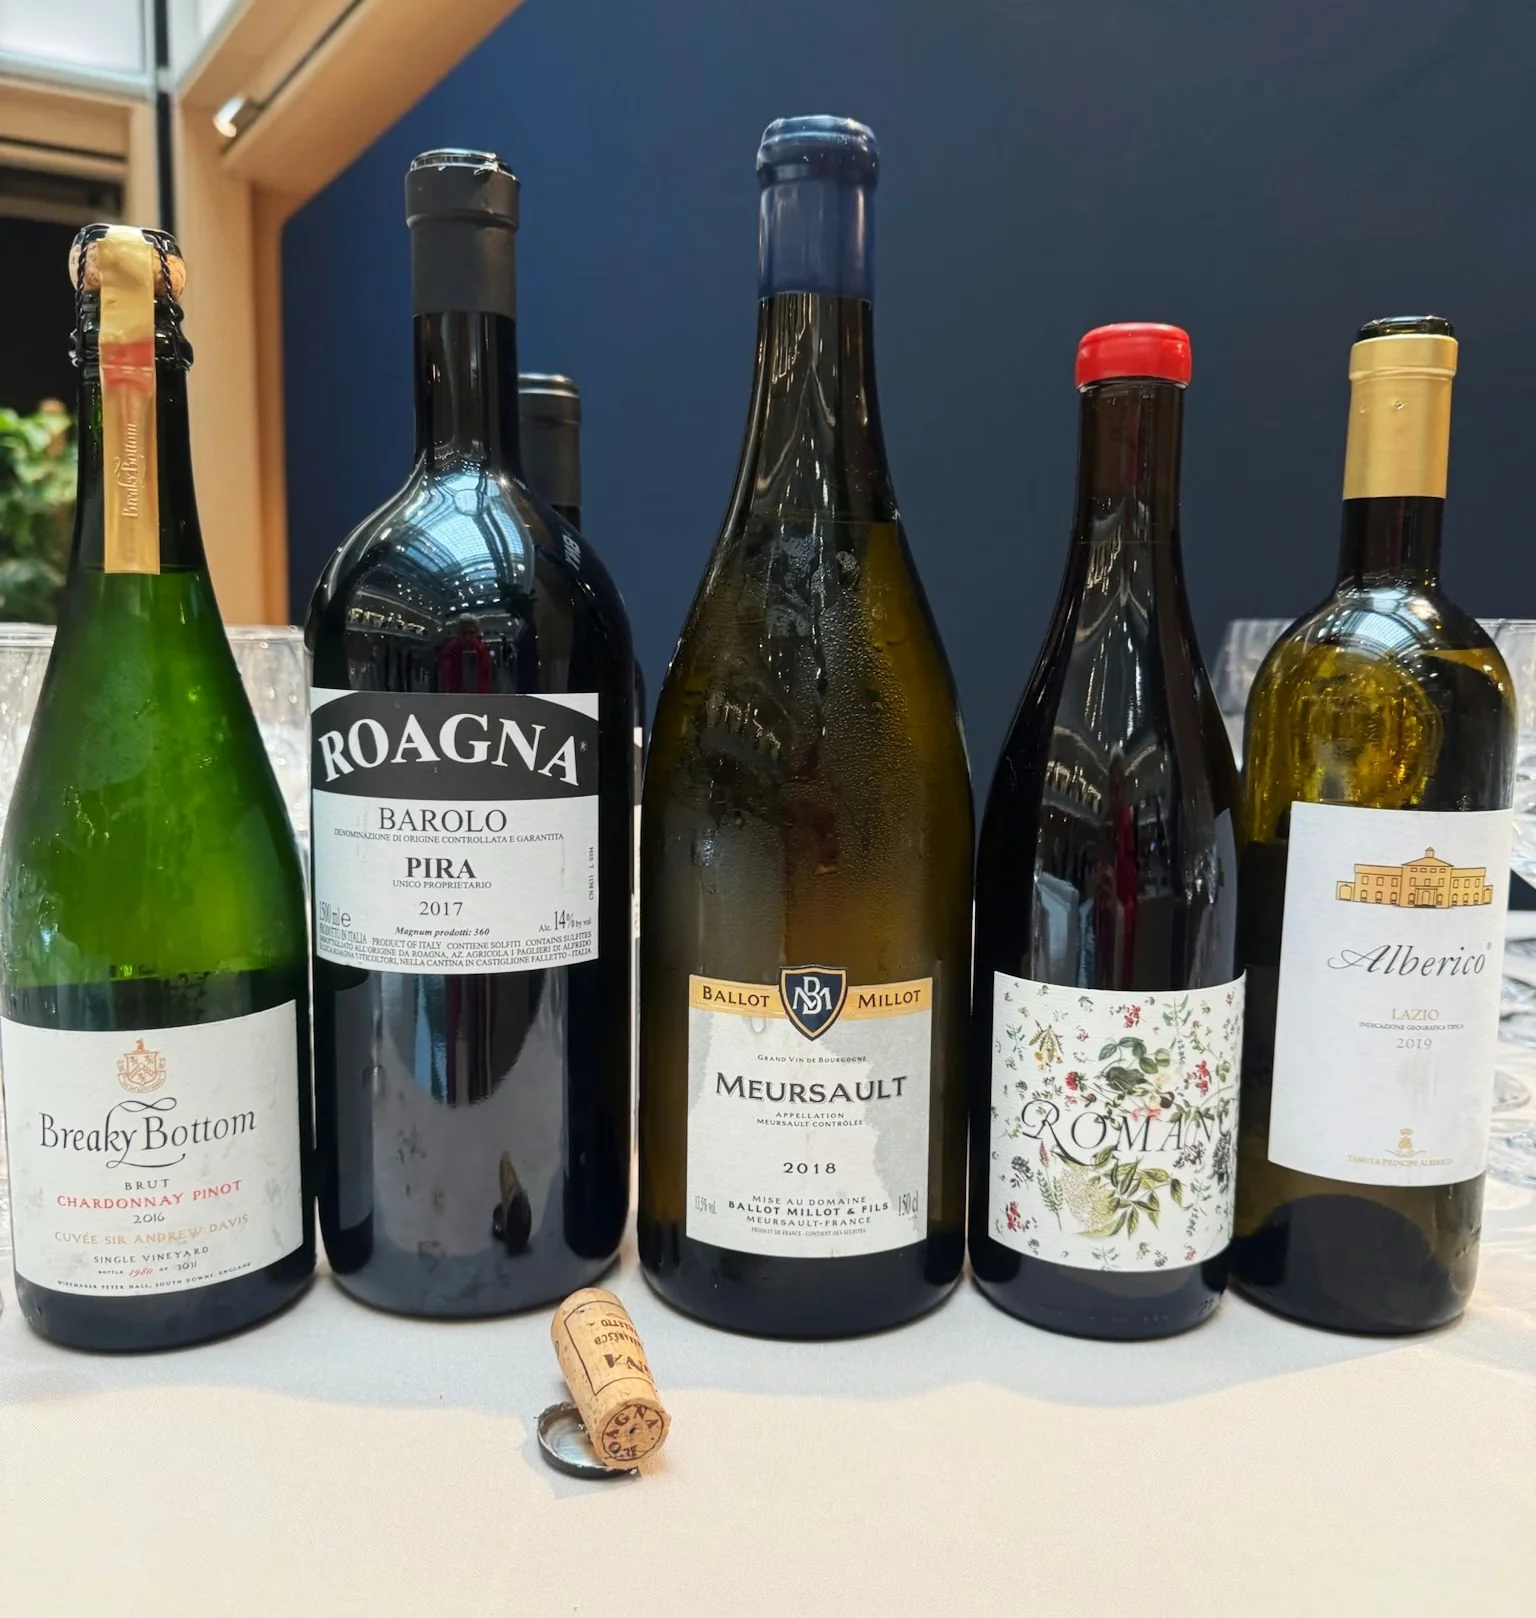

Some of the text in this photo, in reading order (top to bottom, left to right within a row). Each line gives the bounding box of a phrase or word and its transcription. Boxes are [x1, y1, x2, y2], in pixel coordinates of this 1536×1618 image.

[120, 423, 139, 472] Bottom
[317, 713, 579, 787] ROAGNA
[378, 806, 507, 833] BAROLO
[334, 828, 391, 842] DENOMINAZIONE
[393, 834, 402, 842] DI
[403, 835, 440, 843] ORIGINE
[517, 833, 564, 842] GARANTITA
[405, 856, 477, 879] PIRA
[392, 879, 492, 889] UNICO PROPRIETARIO
[419, 901, 463, 916] 2017
[538, 924, 552, 932] Alc.
[554, 910, 575, 930] 14%
[575, 920, 582, 929] by
[348, 930, 367, 944] ITALIA
[372, 937, 406, 949] PRODUCT
[407, 941, 417, 949] OF
[419, 941, 441, 950] ITALY
[447, 941, 489, 950] CONTIENE
[490, 940, 520, 949] SOLFITI
[525, 936, 562, 947] CONTAINS
[563, 930, 592, 942] SULFITES
[395, 926, 490, 938] Magnum prodotti: 360
[355, 944, 396, 957] ALL'ORIGINE
[411, 951, 449, 960] ROAGNA,
[466, 950, 509, 959] AGRICOLA
[516, 946, 551, 957] PAGLIERI
[553, 944, 561, 952] DI
[562, 940, 592, 951] ALFREDO
[400, 956, 425, 967] NELLA
[425, 958, 464, 967] CANTINA
[465, 958, 474, 967] IN
[475, 956, 530, 967] CASTIGLIONE
[531, 952, 567, 963] FALLETTO
[572, 947, 592, 958] ITALIA
[1327, 944, 1485, 976] Alberico
[703, 985, 770, 1008] BALLOT
[858, 989, 921, 1009] MILLOT
[1391, 1008, 1440, 1021] LAZIO
[1358, 1021, 1406, 1031] INDICAZIONE
[1406, 1023, 1446, 1031] GEOGRAFICA
[1396, 1037, 1432, 1050] 2019
[757, 1054, 786, 1063] GRAND
[715, 1071, 908, 1104] MEURSAULT
[756, 1118, 864, 1127] MEURSAULT CONTRÔLÉE
[39, 1097, 257, 1168] Breaky Bottom
[783, 1162, 836, 1174] 2018
[125, 1178, 170, 1191] BRUT
[57, 1180, 242, 1209] CHARDONNAY PINOT
[752, 1195, 781, 1205] MISE
[809, 1196, 867, 1206] DOMAINE
[728, 1200, 780, 1215] BALLOT
[787, 1207, 840, 1217] MILLOT
[862, 1202, 889, 1214] FILS
[133, 1212, 165, 1224] 2016
[746, 1215, 872, 1227] MEURSAULT-FRANCE
[55, 1214, 249, 1245] CUVÉE SIR ANDREW DAVIS
[94, 1246, 209, 1264] SINGLE VINEYARD
[155, 1279, 182, 1287] SOUTH
[219, 1262, 252, 1276] ENGLAND
